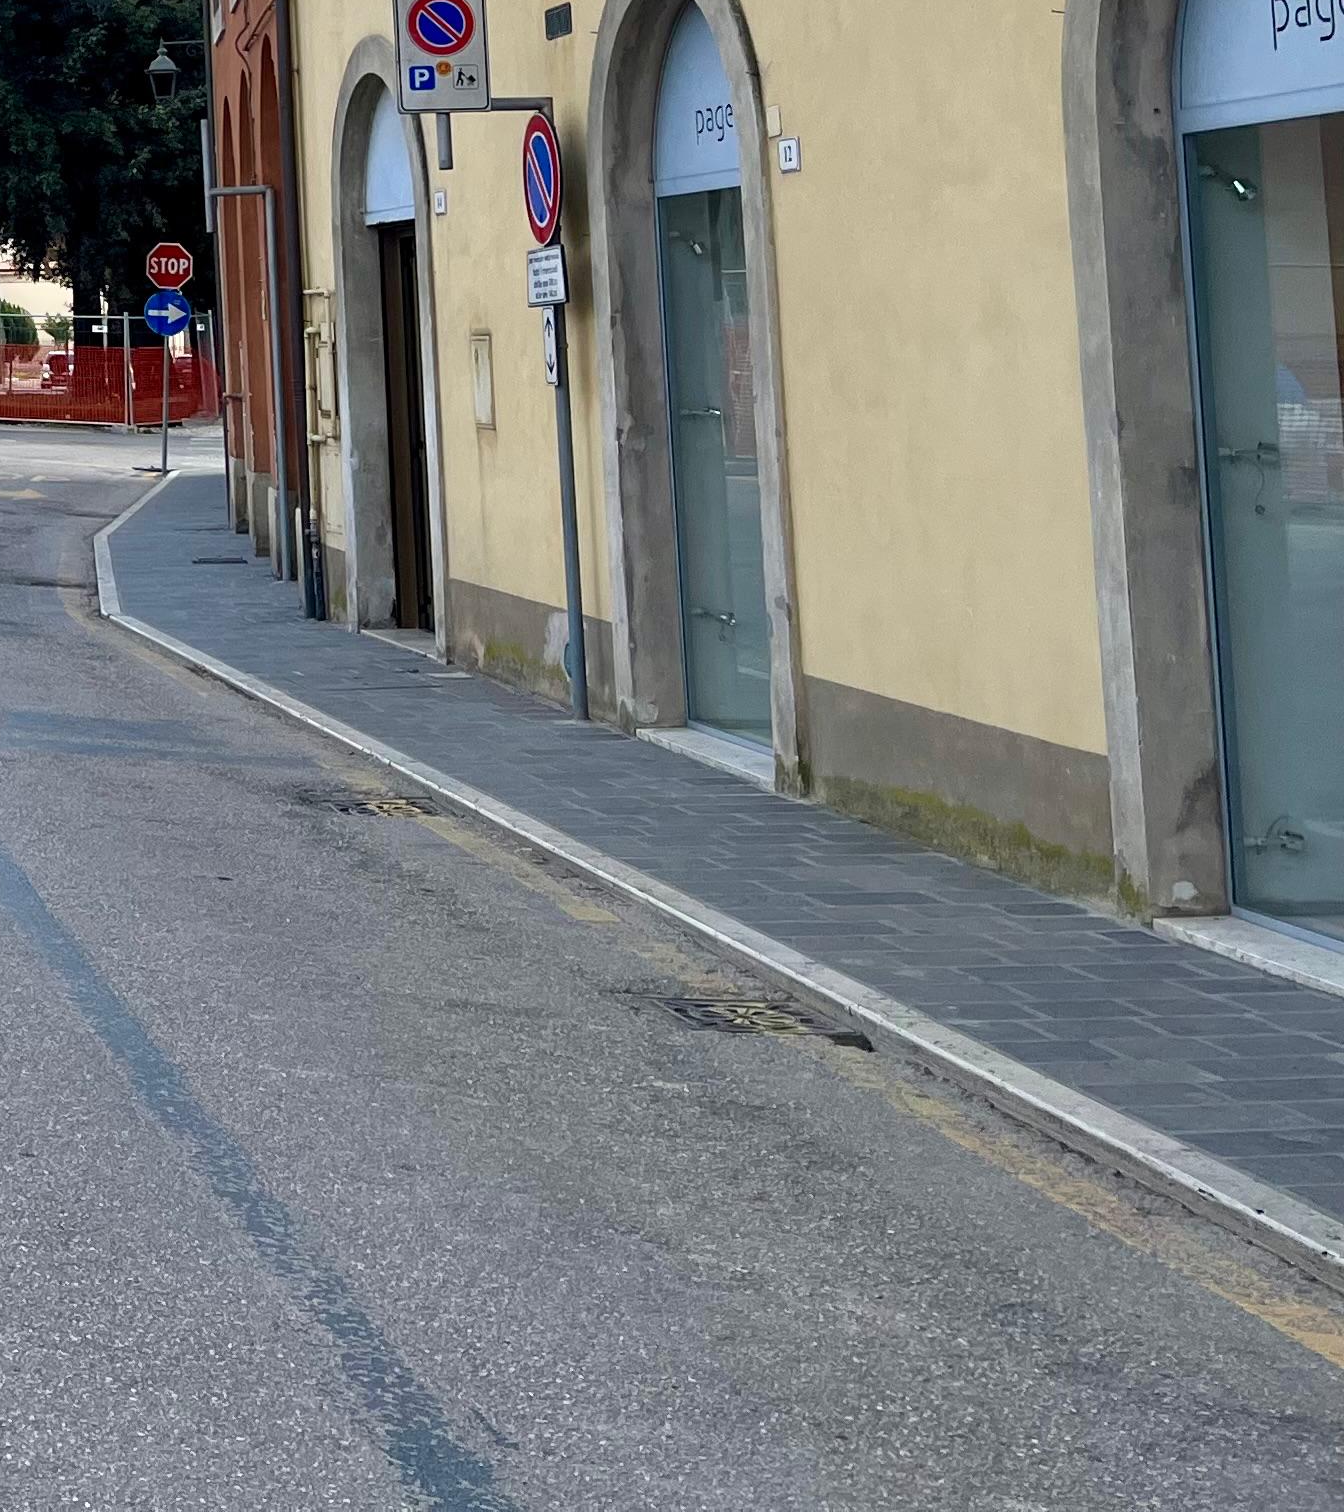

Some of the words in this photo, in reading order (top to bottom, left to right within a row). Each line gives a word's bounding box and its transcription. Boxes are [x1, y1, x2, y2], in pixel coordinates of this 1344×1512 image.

[414, 68, 430, 88] P
[784, 145, 793, 163] 12
[150, 257, 189, 275] STOP
